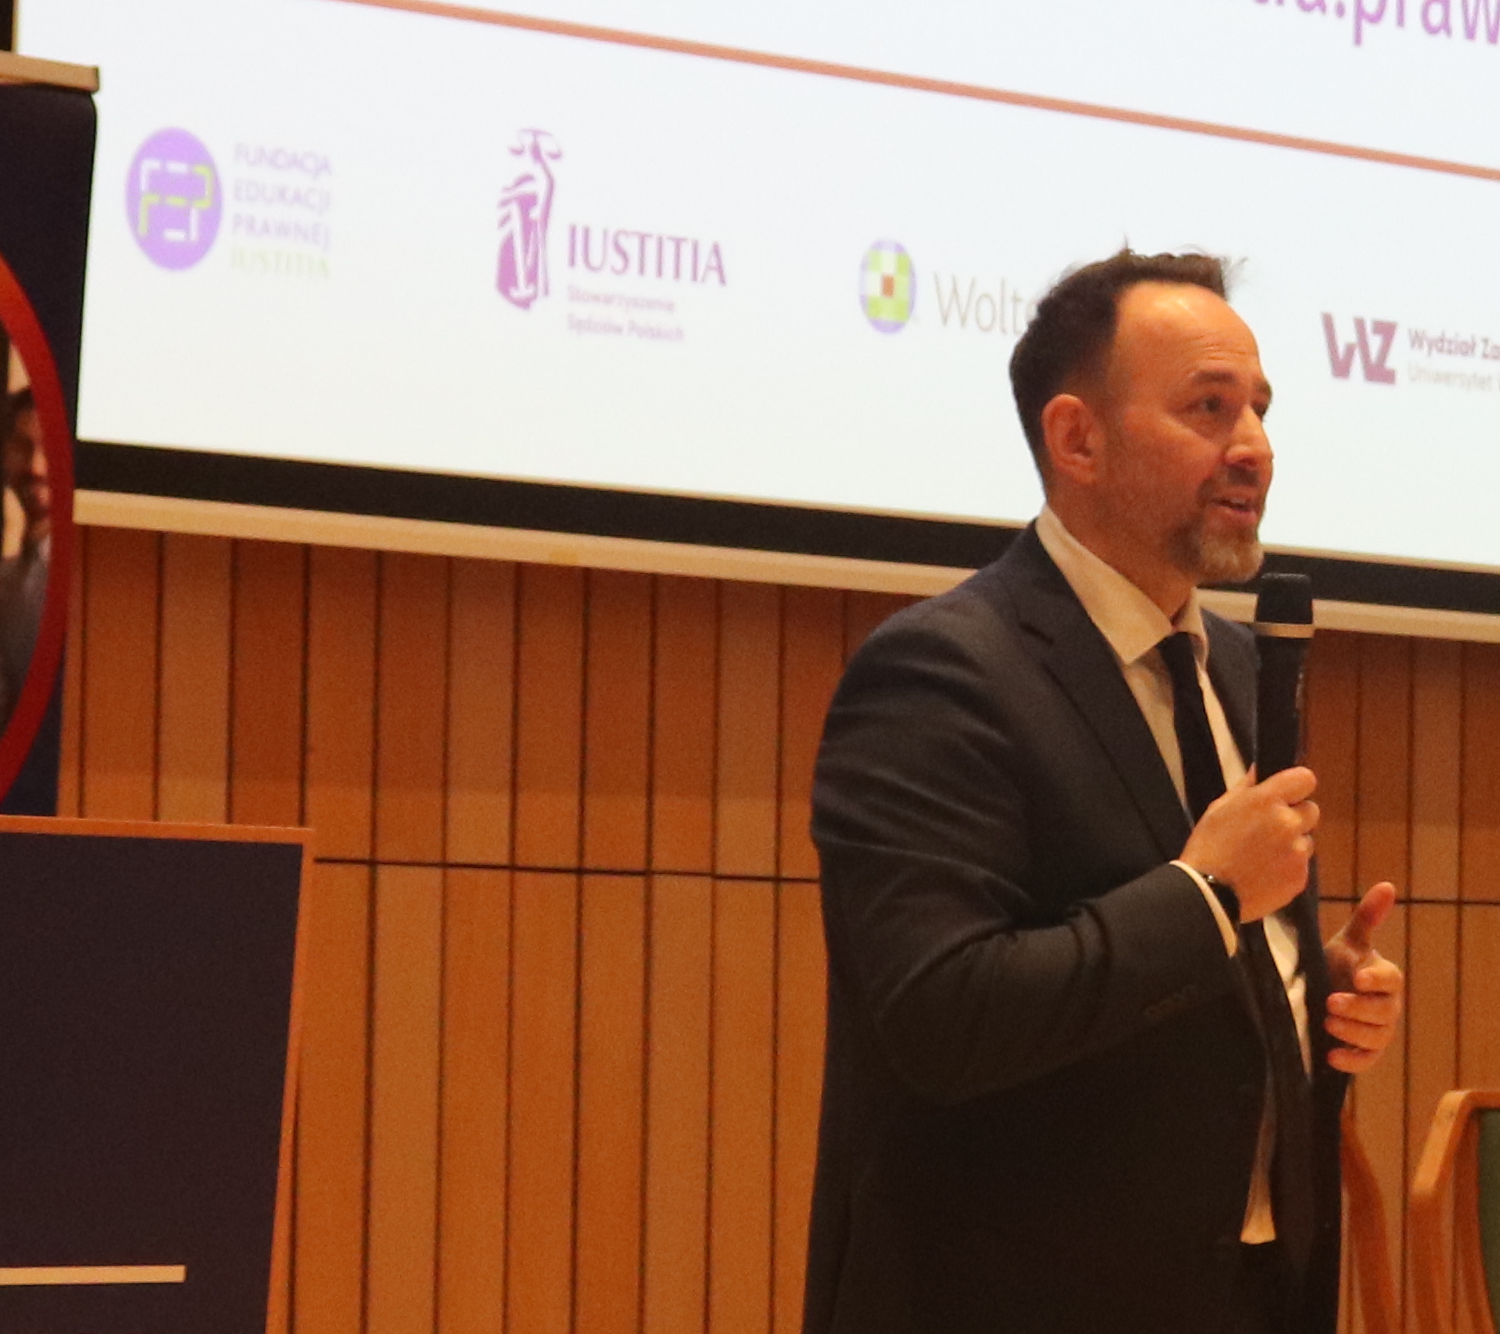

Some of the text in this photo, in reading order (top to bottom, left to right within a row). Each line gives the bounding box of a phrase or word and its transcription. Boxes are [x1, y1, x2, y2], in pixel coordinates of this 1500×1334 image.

[234, 142, 332, 179] FUNDACJA
[232, 213, 330, 253] PRAWNEJ
[567, 223, 727, 286] IUSTITIA
[1320, 311, 1398, 385] WZ
[1408, 326, 1476, 359] Wydział
